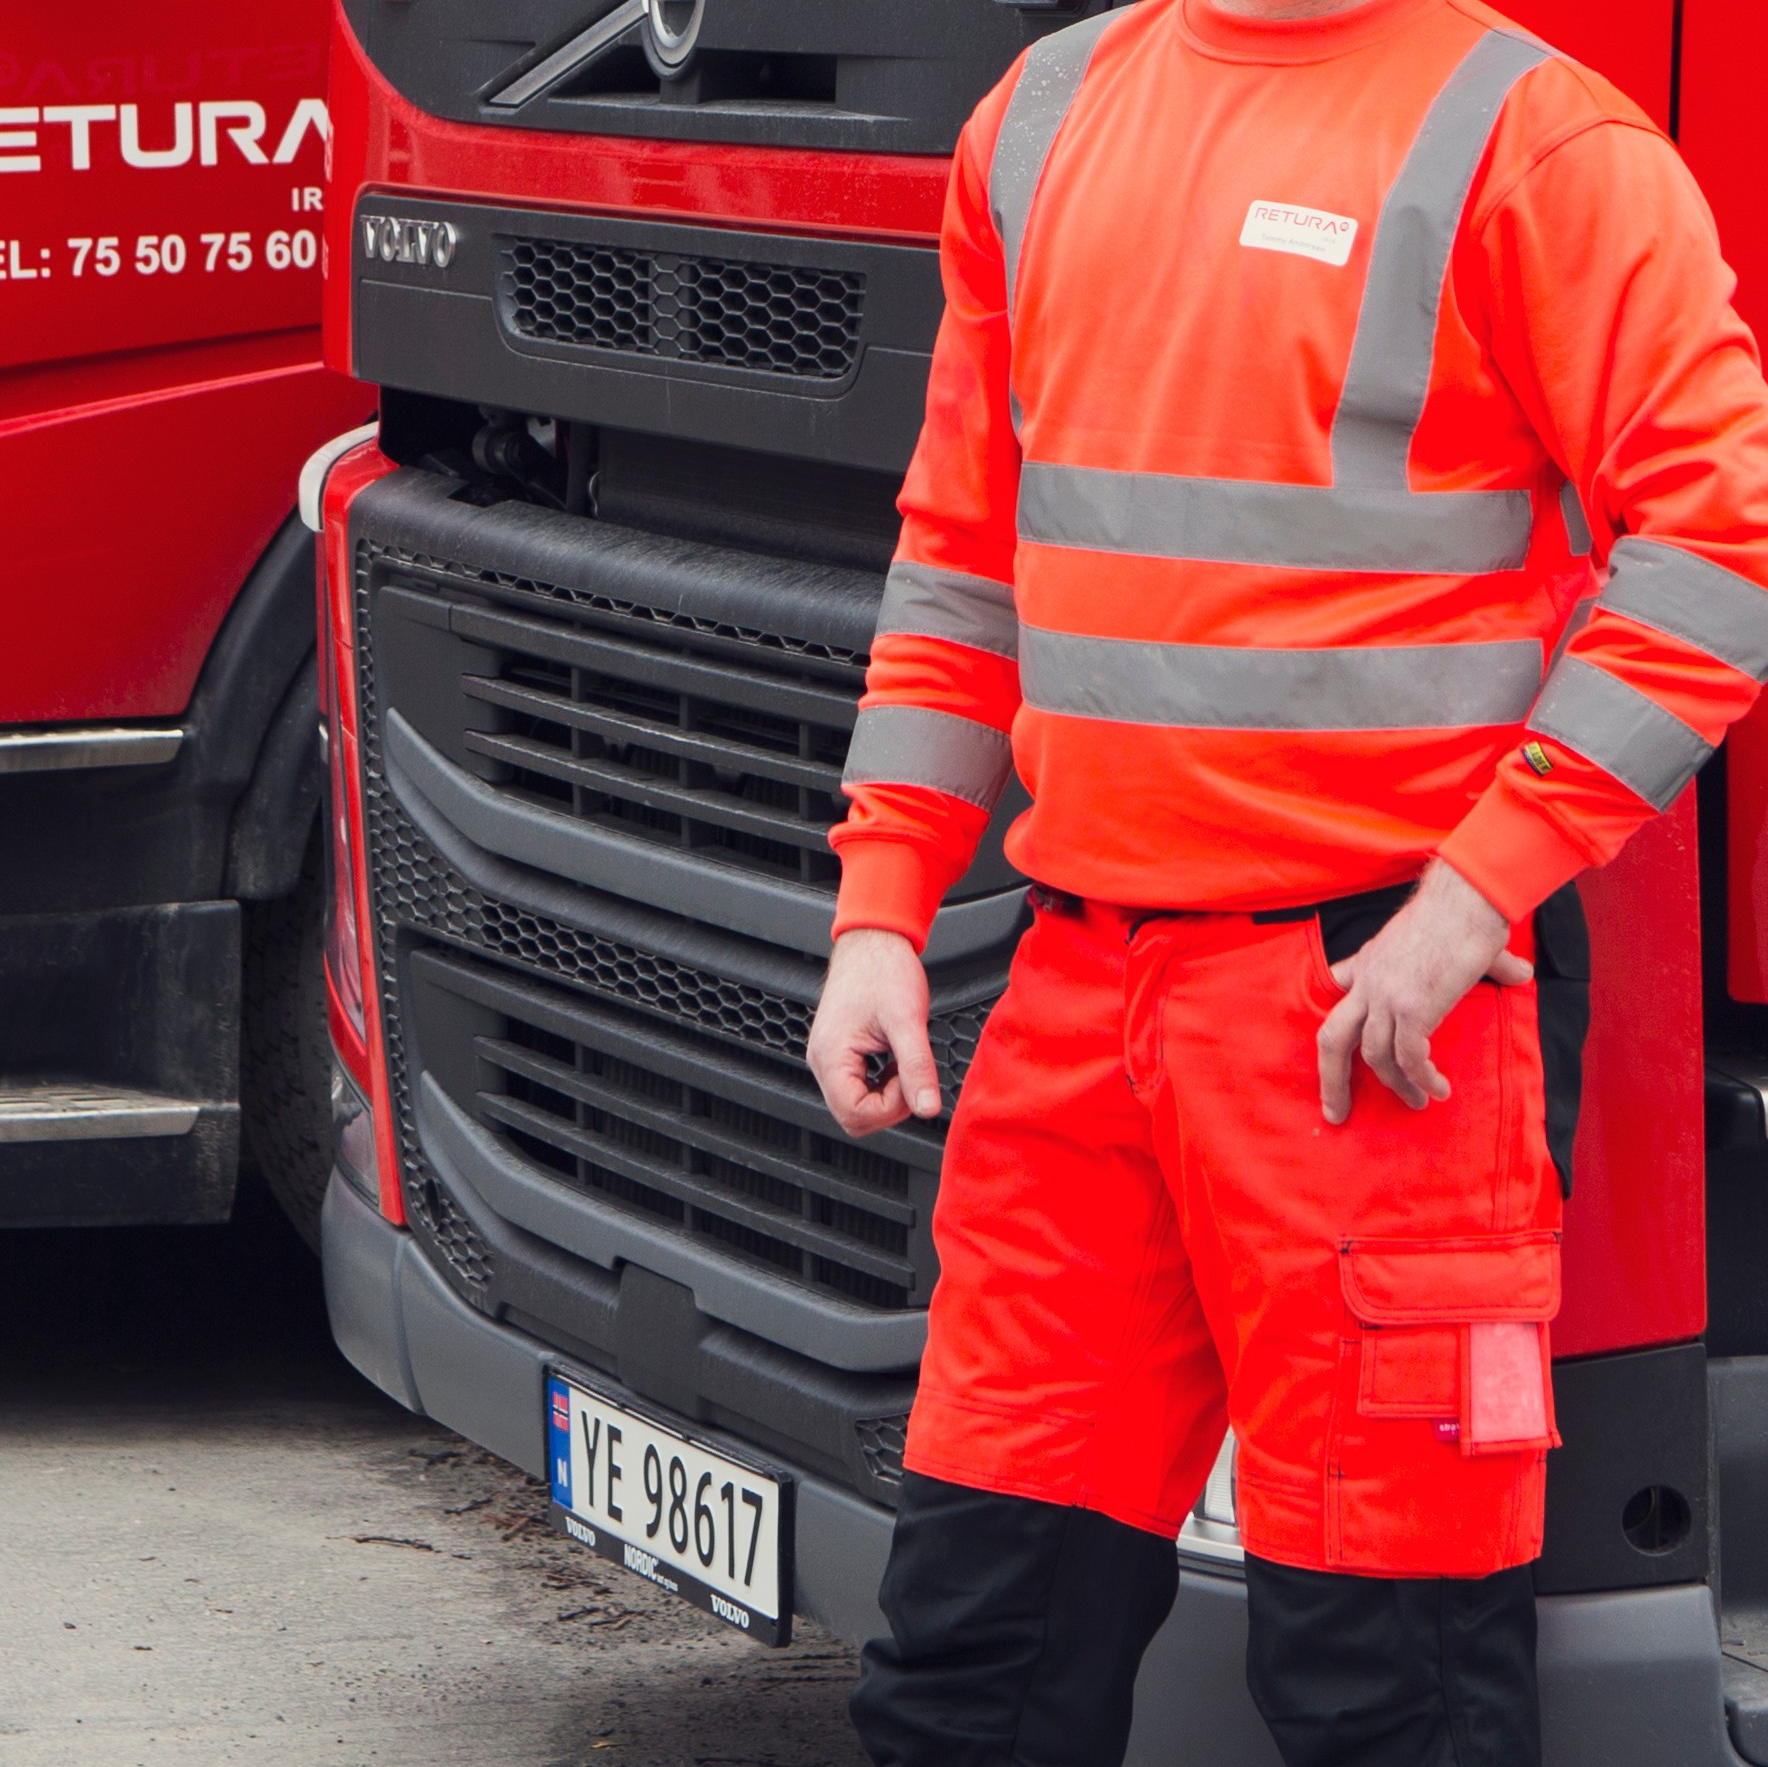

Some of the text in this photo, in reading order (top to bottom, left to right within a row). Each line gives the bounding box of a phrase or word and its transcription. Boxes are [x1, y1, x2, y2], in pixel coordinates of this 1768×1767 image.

[291, 187, 324, 212] IR
[1255, 207, 1337, 235] RETURA
[67, 236, 120, 277] 75
[134, 234, 186, 274] 50
[200, 231, 252, 271] 75
[265, 229, 316, 269] 60
[360, 215, 456, 268] VOLVO
[557, 1458, 569, 1488] N
[581, 1410, 764, 1587] YE 98617
[565, 1516, 597, 1547] VOLVO
[623, 1543, 659, 1579] NORDIC
[710, 1594, 750, 1628] VOLVO
